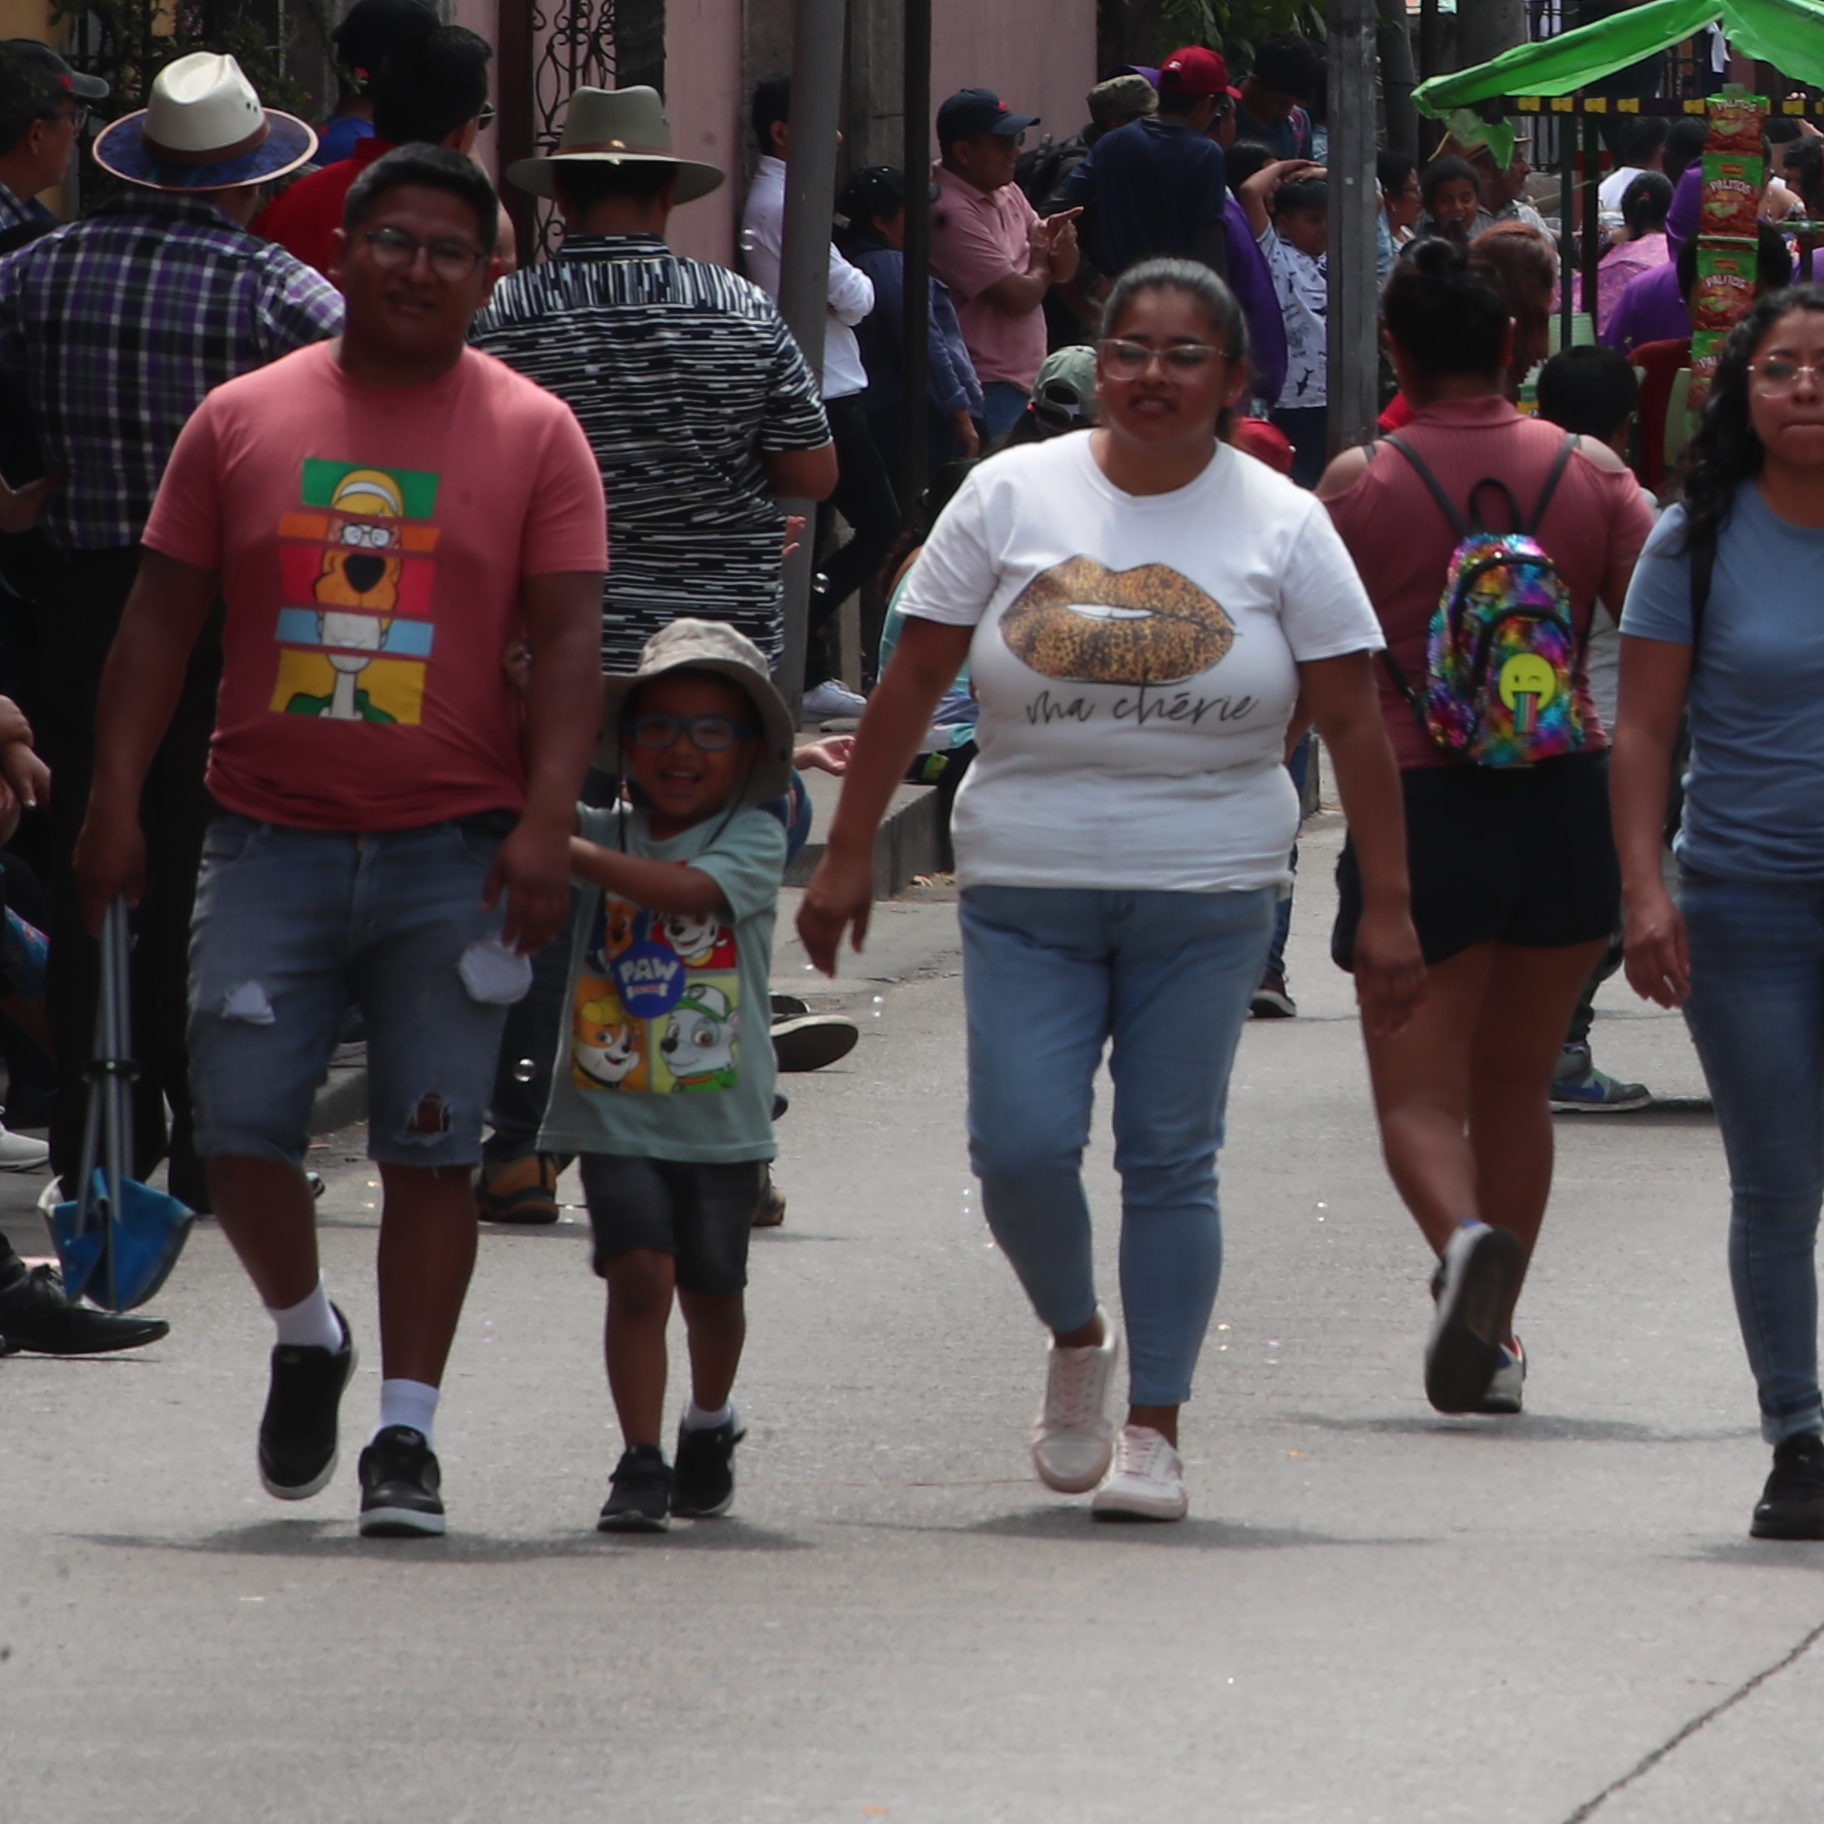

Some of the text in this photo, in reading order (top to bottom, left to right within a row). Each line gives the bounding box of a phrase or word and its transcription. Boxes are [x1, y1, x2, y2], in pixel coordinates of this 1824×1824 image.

[1715, 99, 1757, 112] PALITOS
[1710, 179, 1752, 195] PALITOS
[1705, 275, 1746, 289] PALITOS
[1027, 690, 1095, 725] ma
[619, 957, 680, 983] PAW
